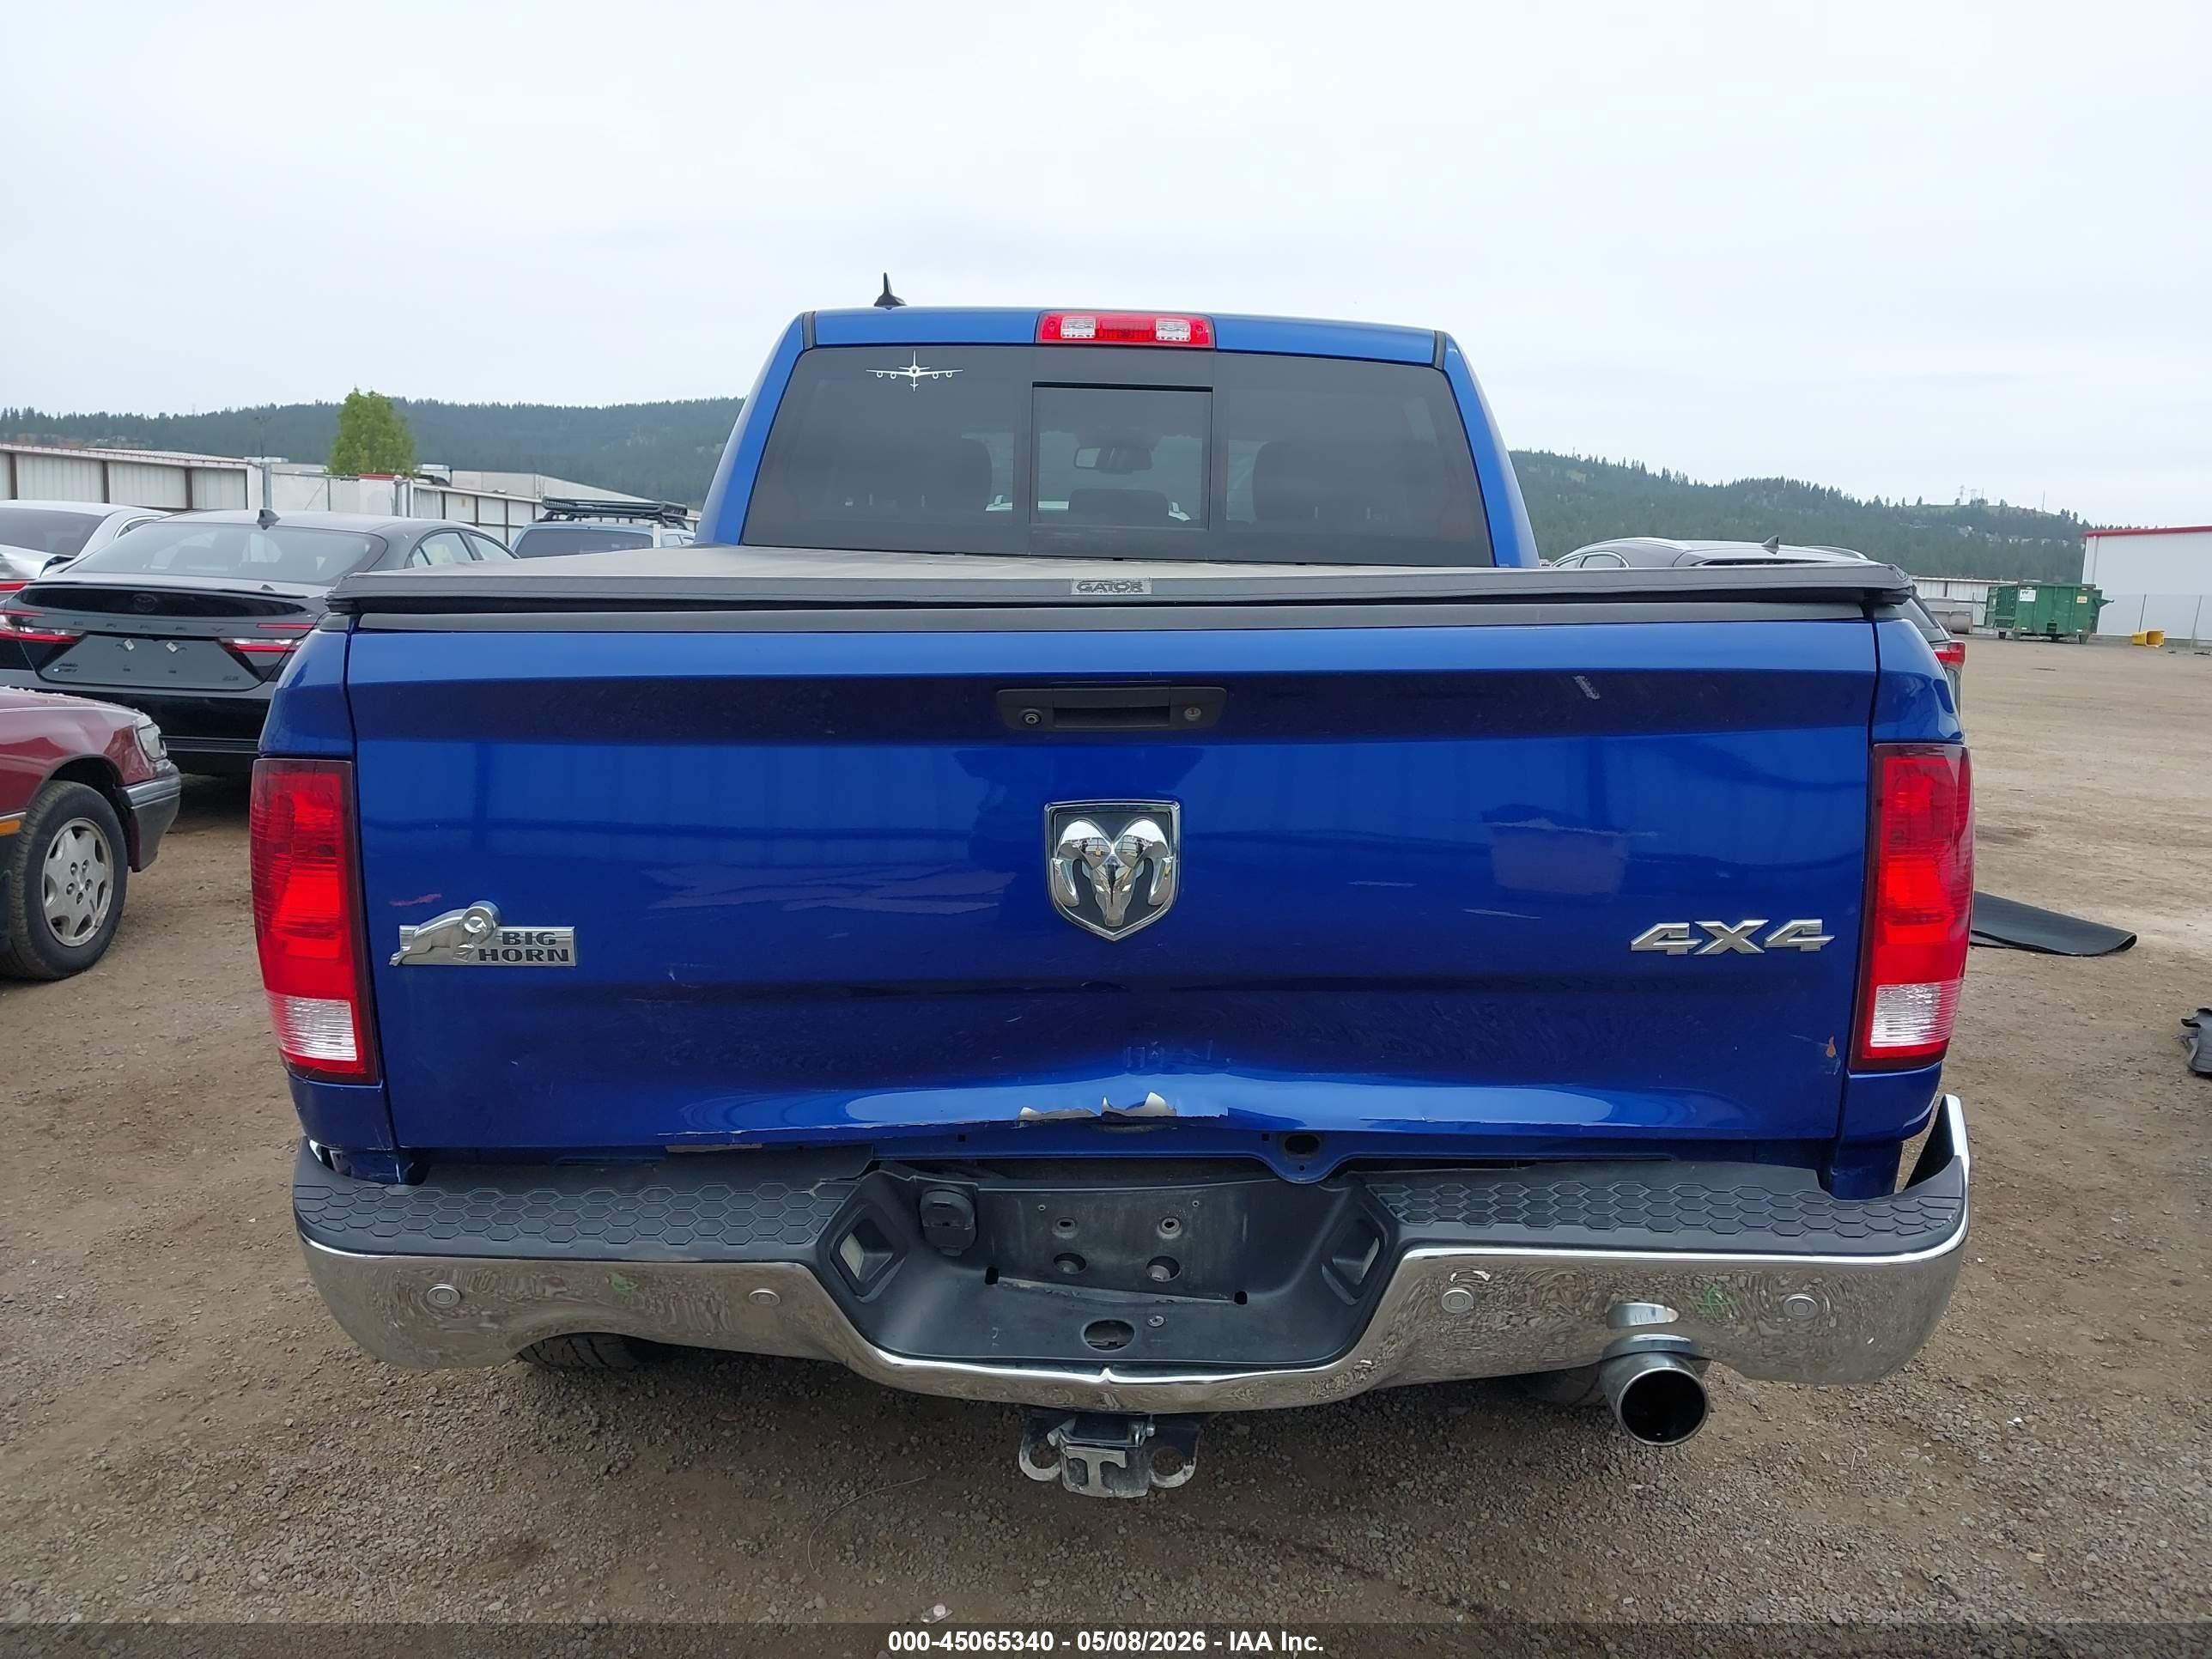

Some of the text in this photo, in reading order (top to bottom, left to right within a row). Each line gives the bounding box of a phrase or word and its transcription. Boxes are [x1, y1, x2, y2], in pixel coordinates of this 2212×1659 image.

[1075, 581, 1144, 592] GATOR
[502, 932, 556, 945] BIG
[478, 948, 568, 962] HORN
